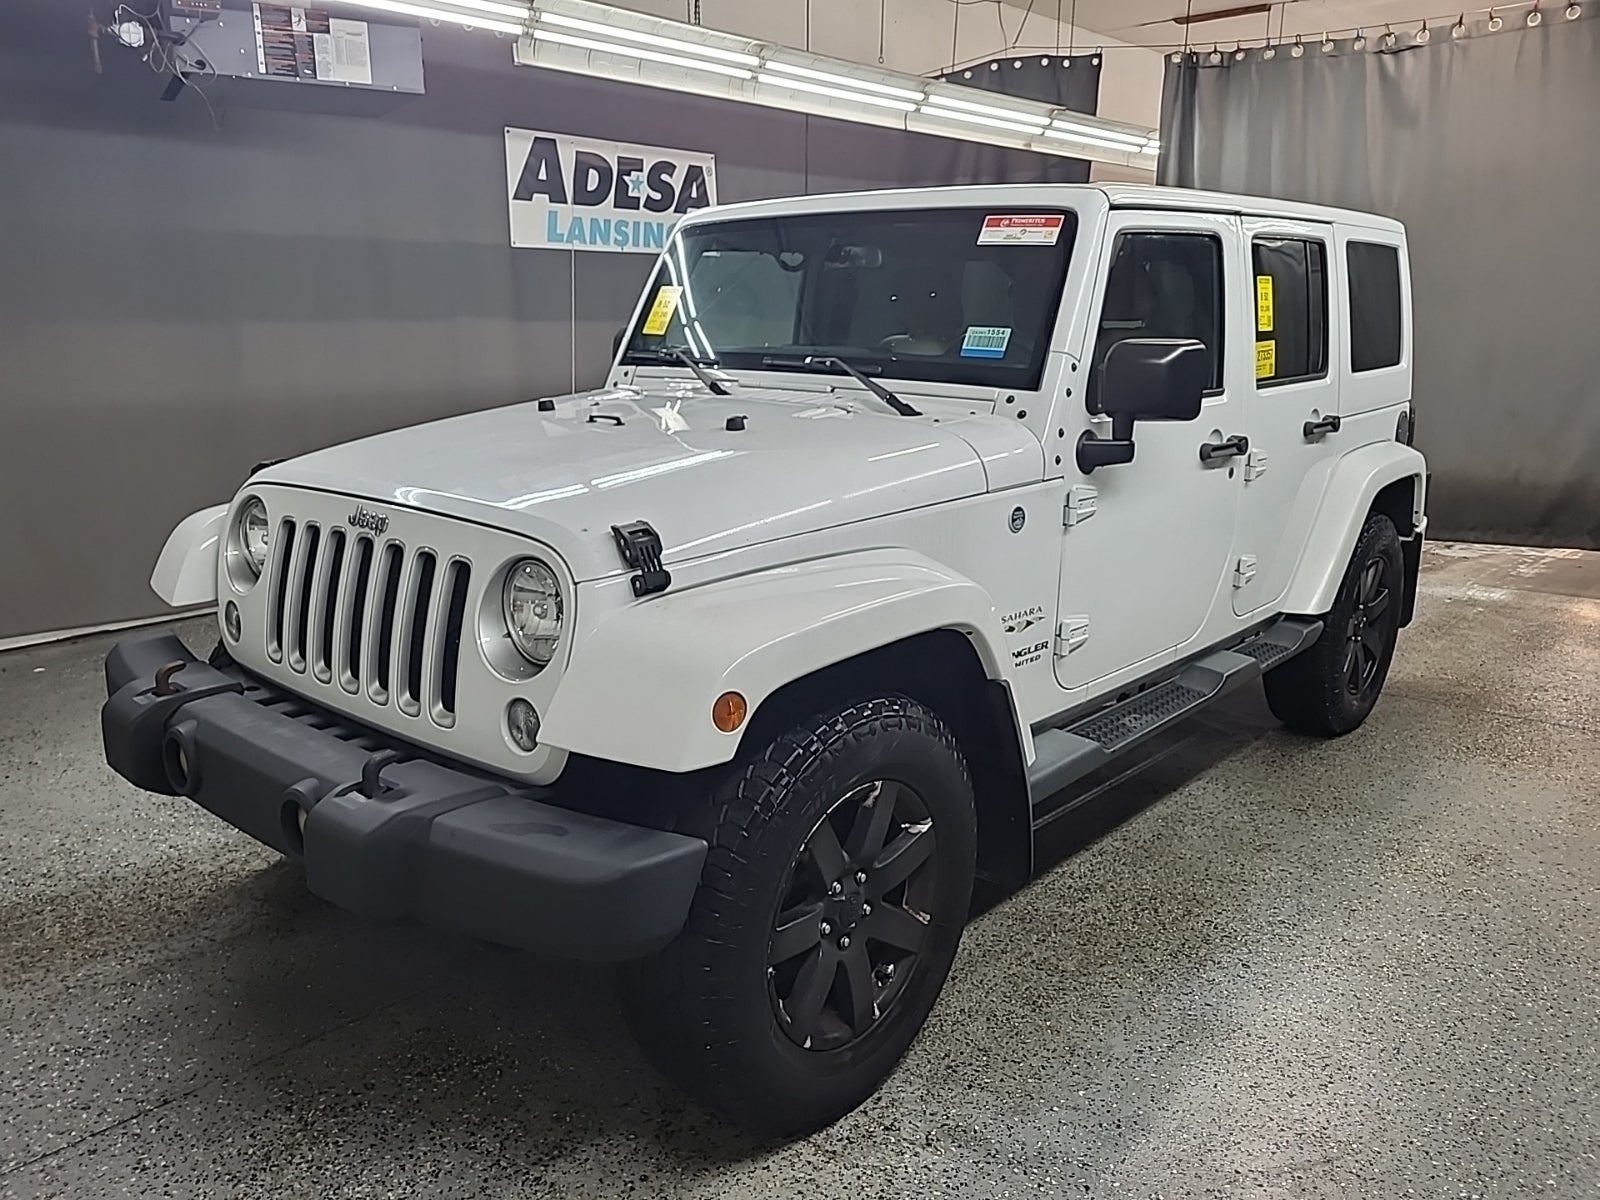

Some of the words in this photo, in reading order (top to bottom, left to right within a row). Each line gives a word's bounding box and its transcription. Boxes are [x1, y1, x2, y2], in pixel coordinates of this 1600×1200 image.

[512, 136, 710, 214] ADESA
[547, 210, 674, 249] LANSIN
[987, 329, 1006, 337] 1554
[348, 504, 390, 537] Jeep
[1001, 606, 1042, 625] SAHARA
[1012, 640, 1049, 659] NGLER
[1014, 654, 1041, 668] MITED
